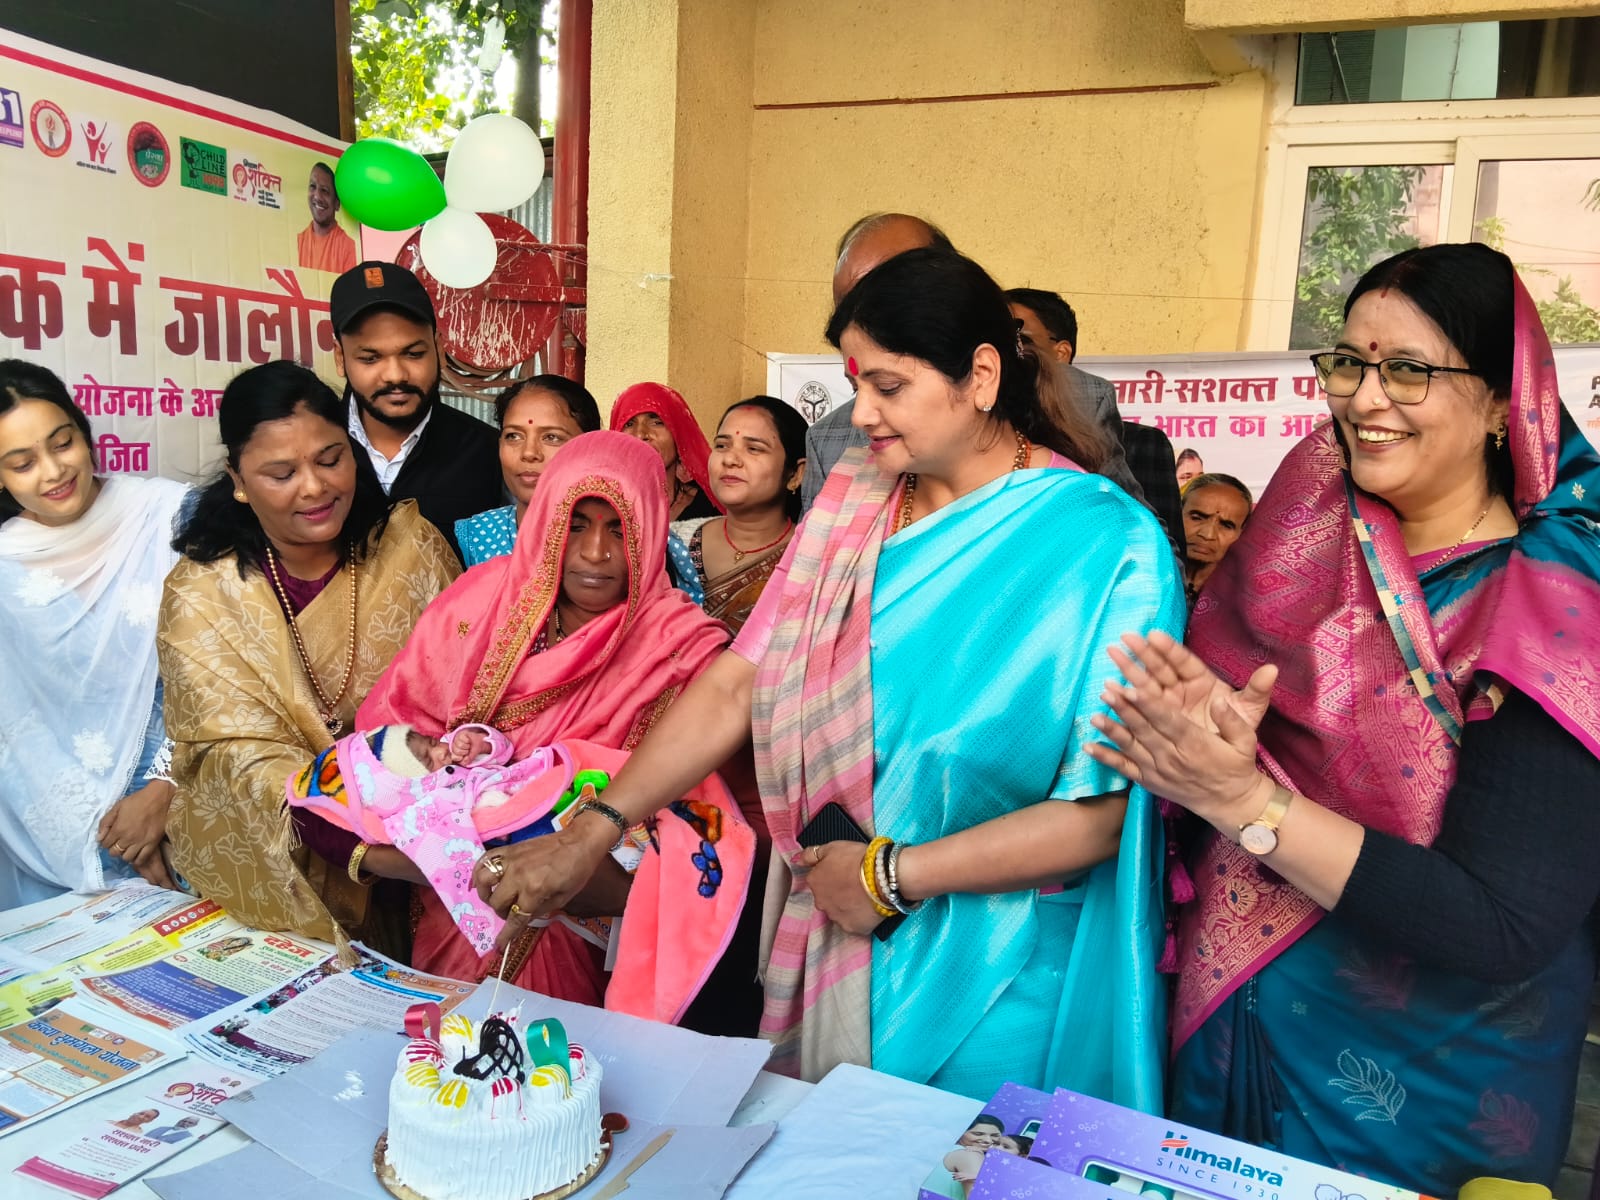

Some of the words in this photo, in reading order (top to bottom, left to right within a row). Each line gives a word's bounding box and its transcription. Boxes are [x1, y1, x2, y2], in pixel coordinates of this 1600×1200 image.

[200, 150, 226, 165] CHILD
[202, 160, 226, 175] LINE
[82, 237, 145, 356] में
[73, 374, 154, 417] योजना
[159, 378, 184, 417] के
[1154, 415, 1218, 438] भारत
[1229, 415, 1267, 438] का
[94, 433, 150, 473] जित
[1156, 1156, 1218, 1184] SINCE
[1232, 1180, 1280, 1200] 1930
[1160, 1130, 1284, 1188] Himalaya
